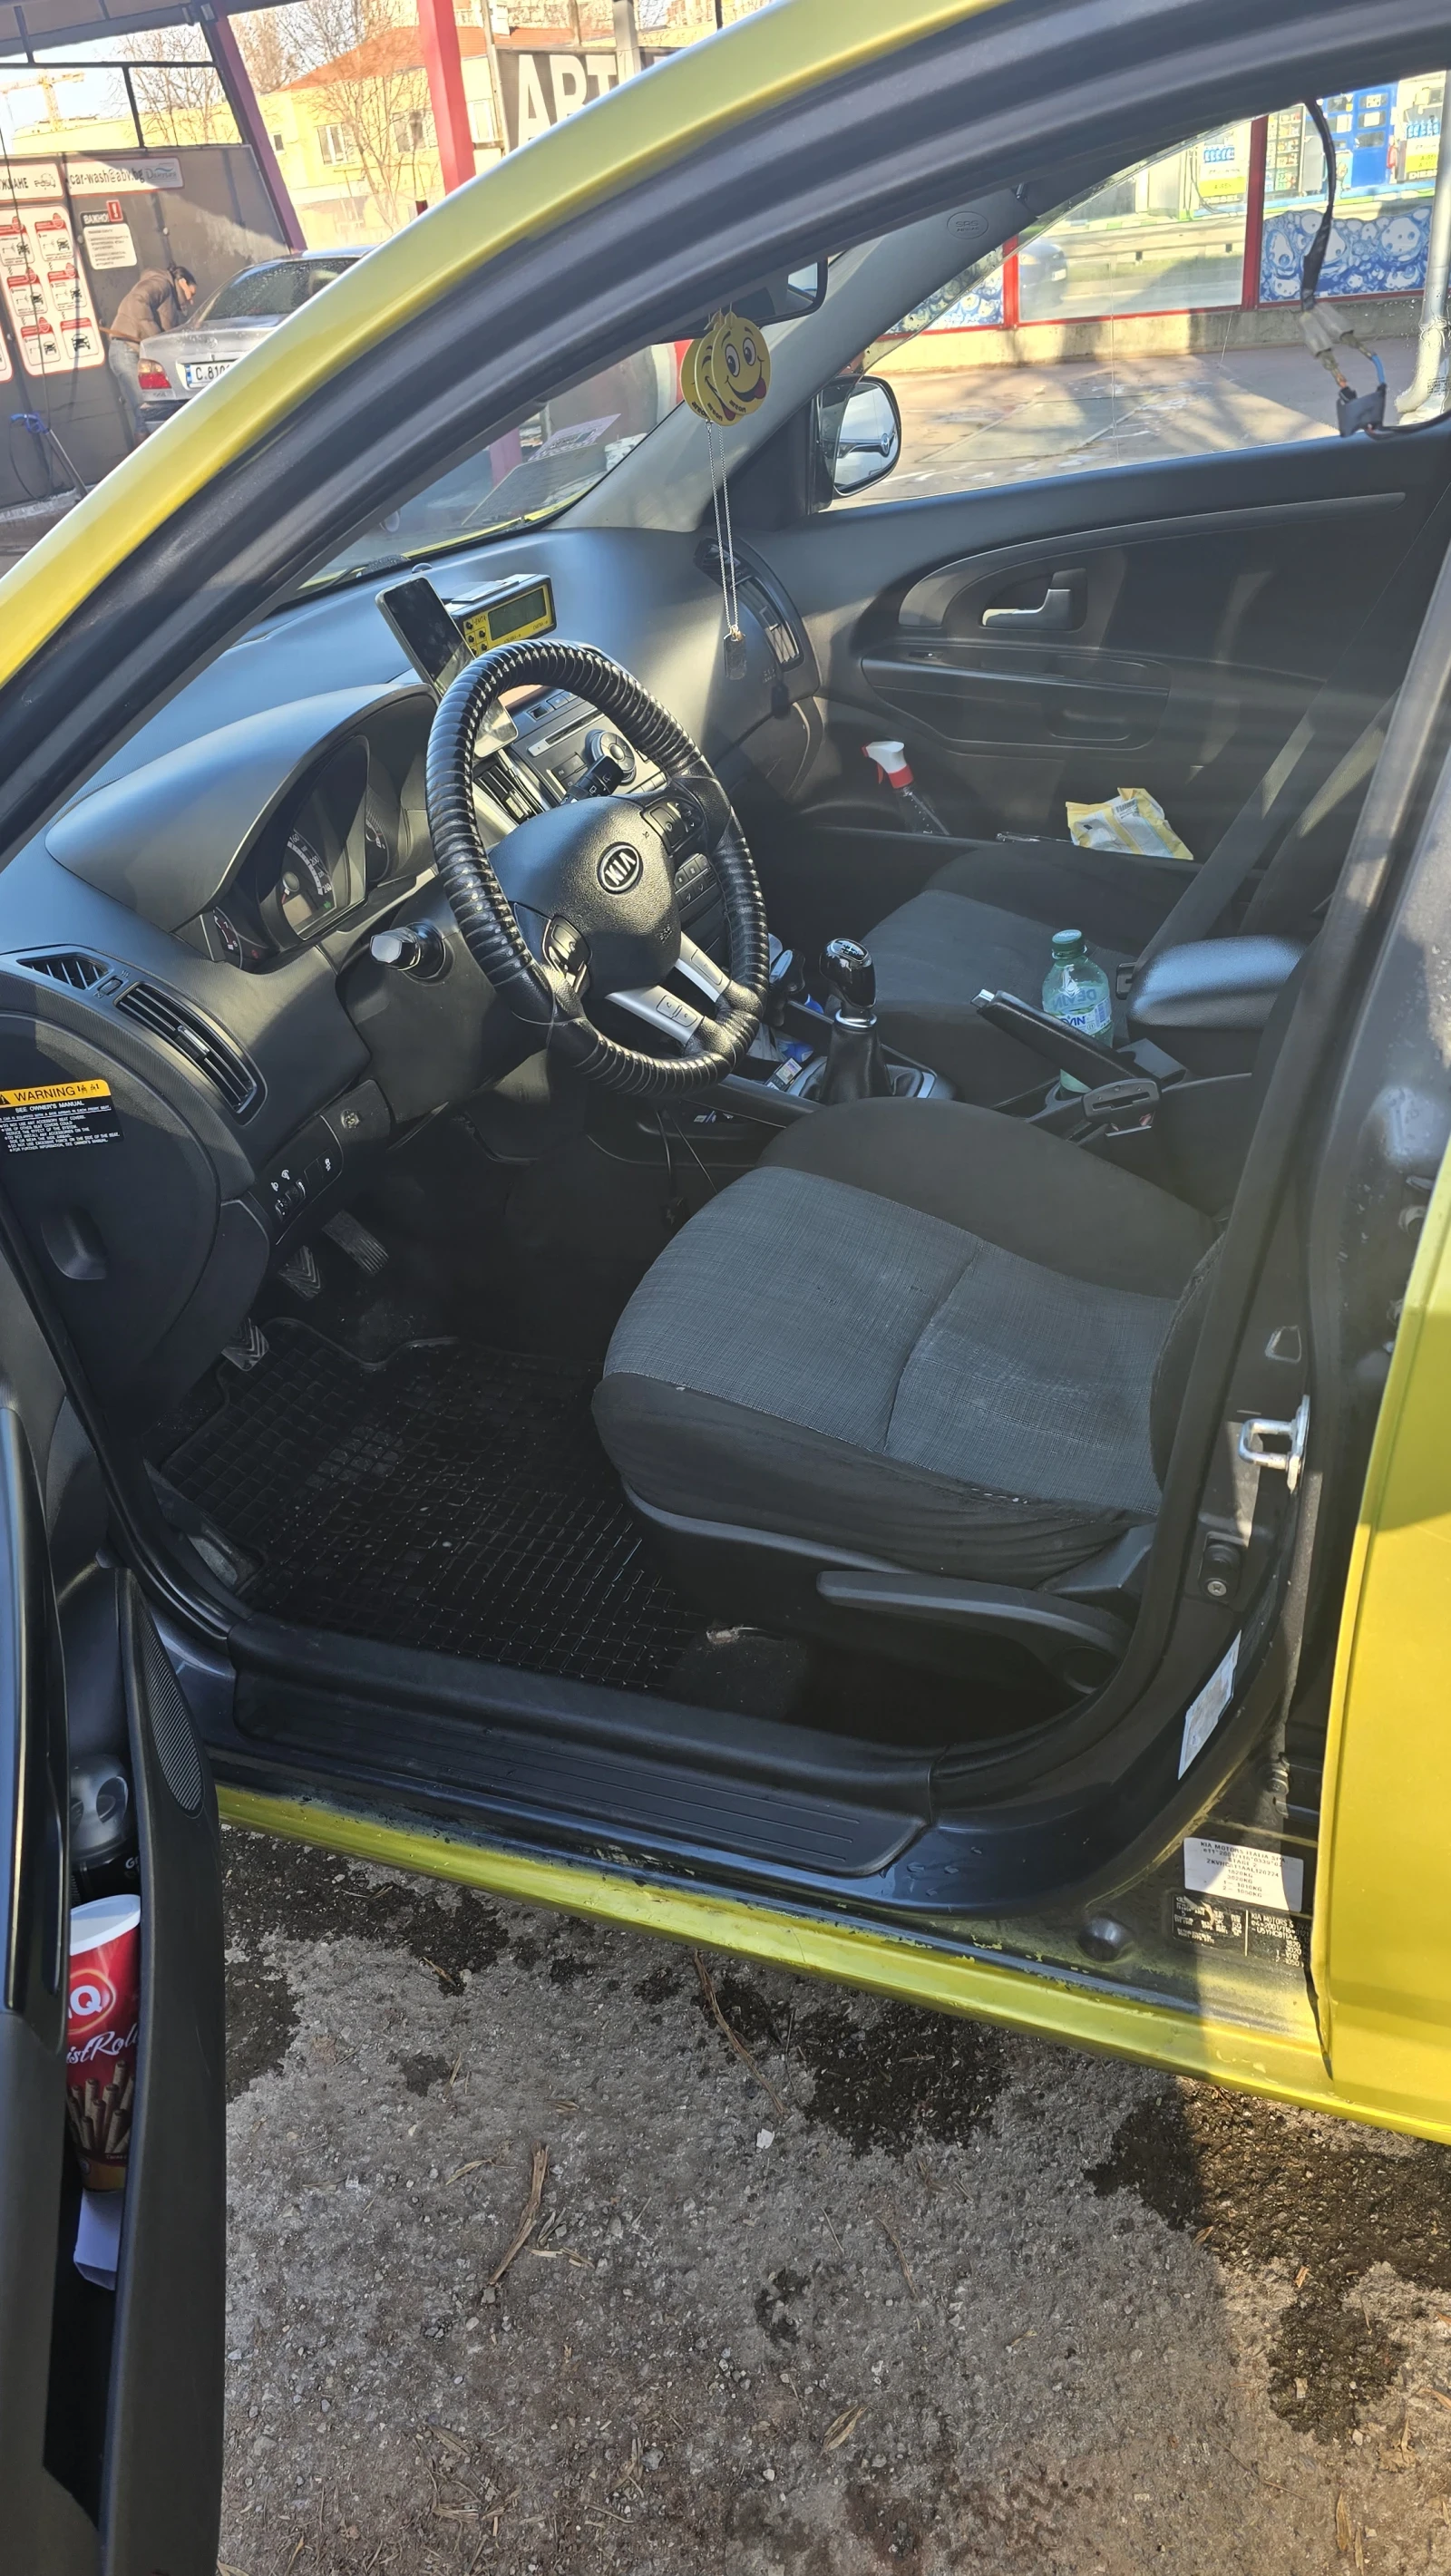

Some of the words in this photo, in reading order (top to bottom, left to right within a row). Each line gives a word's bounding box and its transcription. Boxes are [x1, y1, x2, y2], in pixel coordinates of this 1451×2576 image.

[69, 168, 145, 185] car-wash@abv.bg
[707, 403, 723, 421] areon
[729, 400, 745, 413] areon
[605, 851, 637, 886] KIA
[15, 1086, 75, 1102] WARNING
[1215, 1844, 1244, 1854] MOTORS
[1246, 1851, 1269, 1859] ITALIA
[1228, 1857, 1250, 1865] STAGE
[1263, 1915, 1288, 1926] MOTORS
